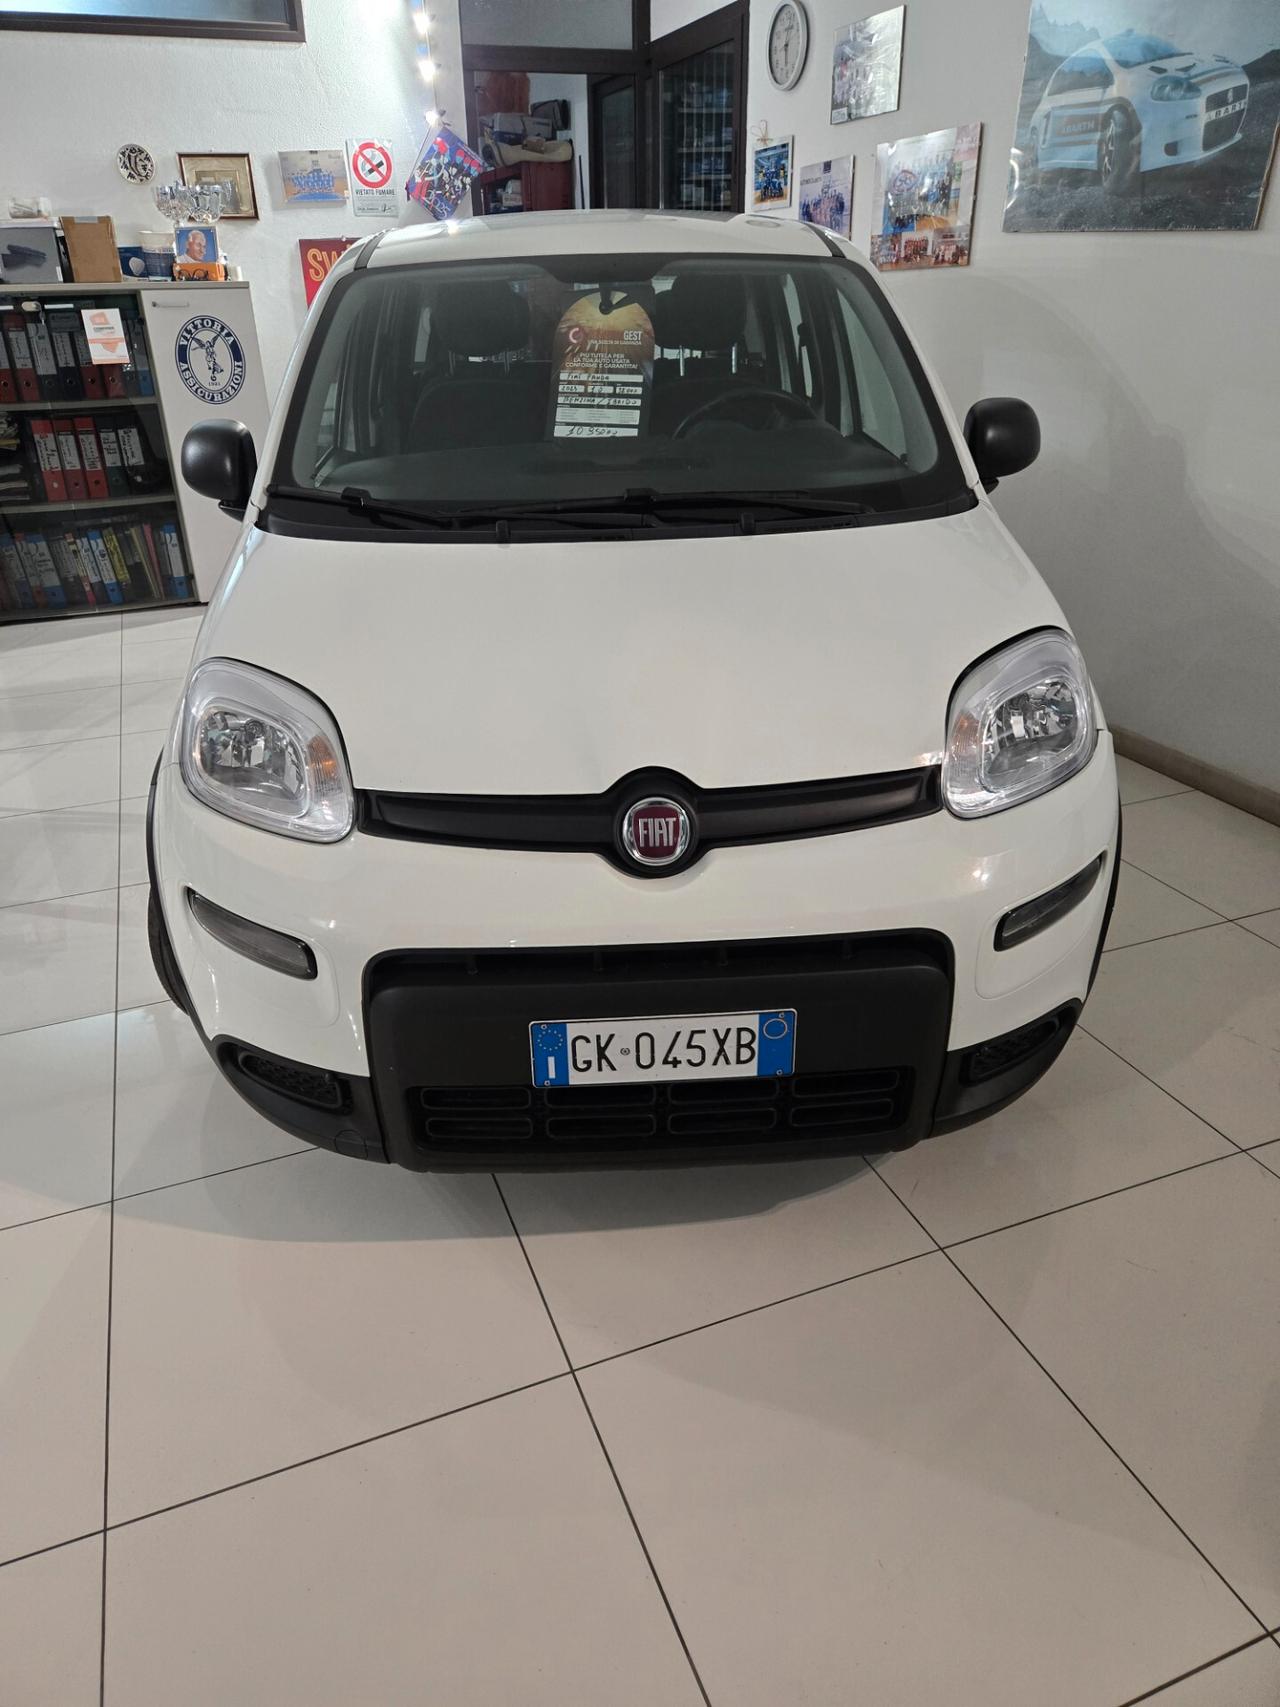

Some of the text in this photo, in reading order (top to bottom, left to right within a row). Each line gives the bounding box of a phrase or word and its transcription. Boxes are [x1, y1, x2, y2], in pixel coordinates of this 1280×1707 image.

[355, 188, 396, 196] VIETATO FUMARE
[180, 319, 235, 345] VITTORIA
[623, 330, 642, 340] GEST
[180, 360, 243, 401] ASSICURAZIONI
[638, 817, 677, 848] FIAT
